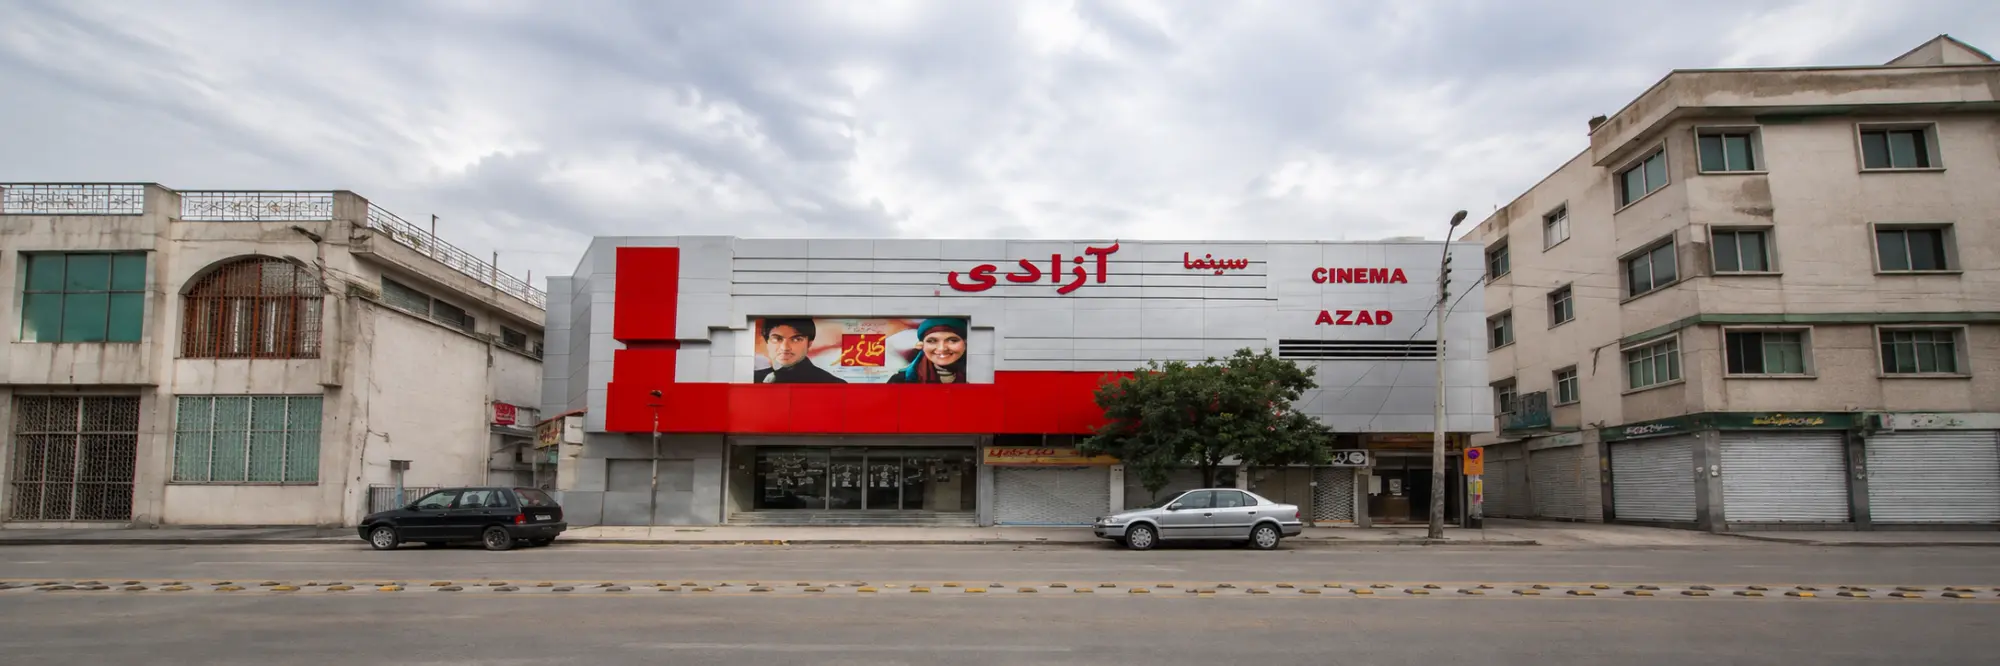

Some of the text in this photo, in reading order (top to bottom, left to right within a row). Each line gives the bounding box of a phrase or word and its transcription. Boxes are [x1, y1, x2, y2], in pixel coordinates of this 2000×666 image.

[948, 242, 1249, 295] سینما آزادی
[1312, 267, 1408, 284] CINEMA
[1315, 310, 1393, 326] AZAD
[831, 334, 887, 366] کلاغ پر
